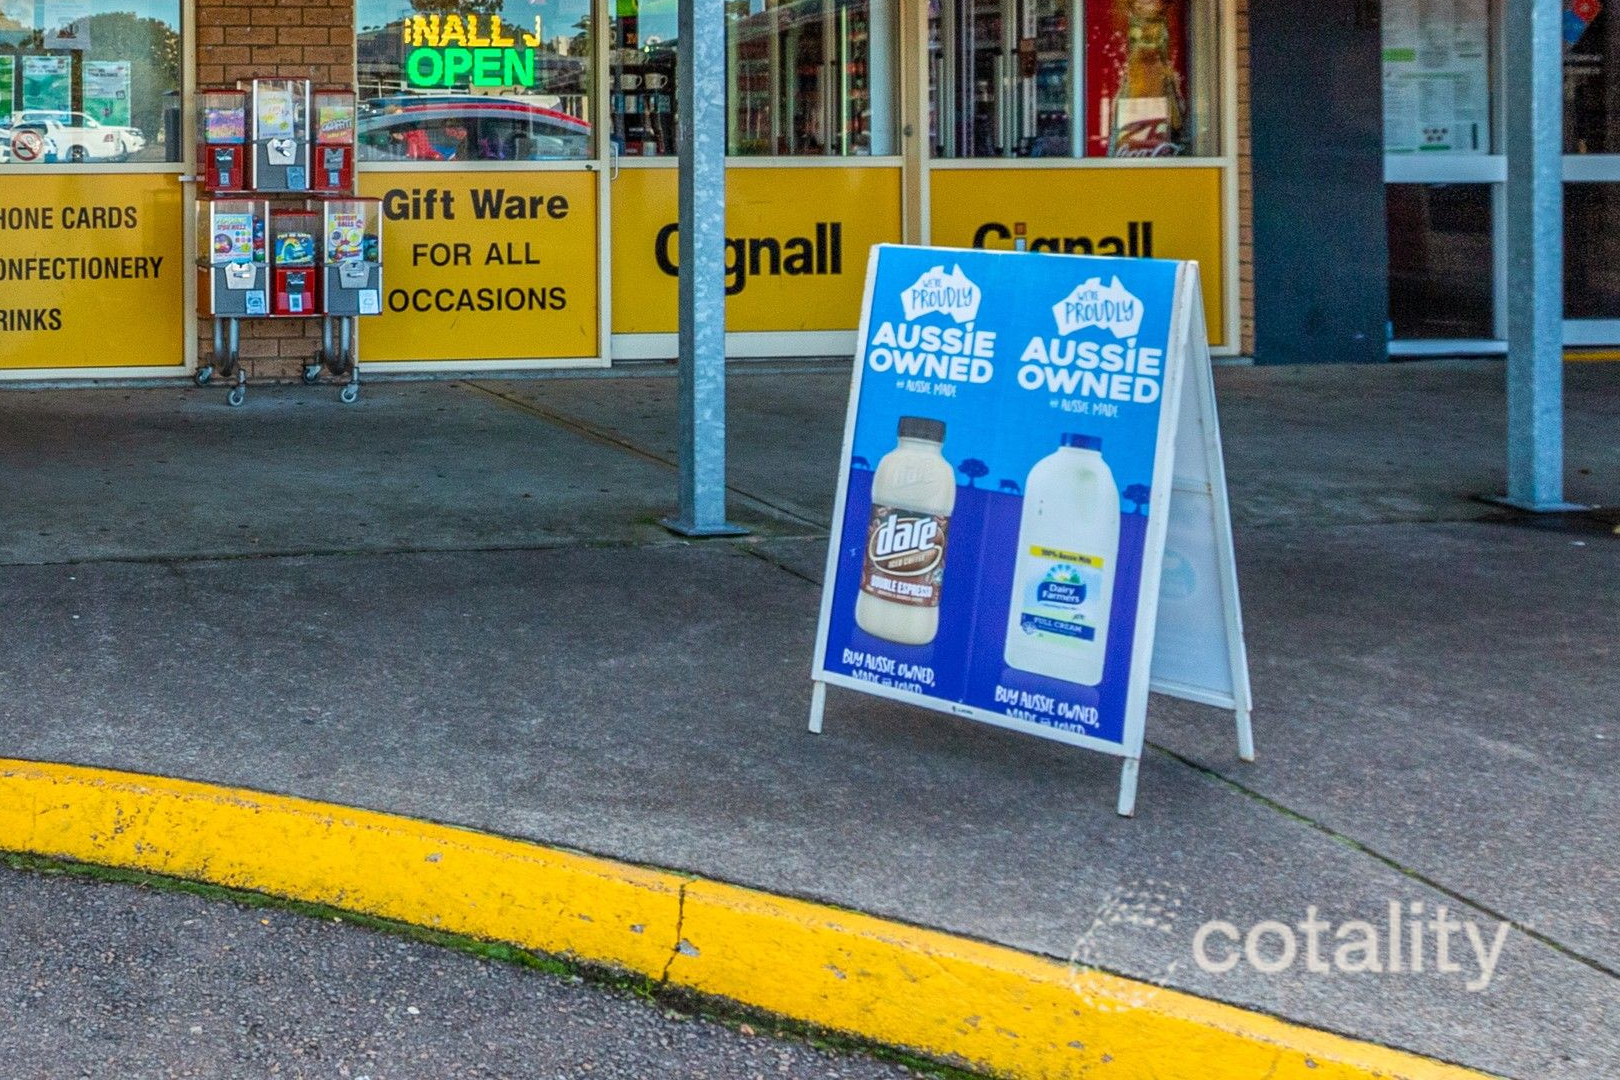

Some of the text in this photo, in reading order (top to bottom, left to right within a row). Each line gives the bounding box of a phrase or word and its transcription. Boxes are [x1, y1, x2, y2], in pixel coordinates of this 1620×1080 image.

[408, 48, 535, 87] OPEN
[61, 206, 137, 229] CARDS
[383, 188, 569, 220] Gift Ware
[413, 242, 541, 266] FOR ALL
[654, 222, 842, 296] Cgnall
[388, 287, 567, 312] OCCASIONS
[912, 286, 973, 309] PROUDLY
[1065, 299, 1134, 324] PROUDLY
[871, 321, 997, 358] AUSSIE
[869, 348, 994, 384] OWNED
[1020, 336, 1163, 376] AUSSIE
[905, 379, 931, 395] AUSSIE
[934, 382, 957, 398] MADE
[1017, 364, 1160, 404] OWNED
[1060, 398, 1089, 415] AUSSIE
[1093, 402, 1119, 418] MADE
[876, 514, 938, 555] dare
[1042, 590, 1080, 603] Farmers
[1049, 584, 1075, 596] Dairy
[1034, 617, 1082, 632] FULL CREAM
[842, 648, 936, 688] BUY AUSSIE OWNED,
[994, 685, 1019, 705] BUY
[1019, 691, 1056, 715] AUSSIE
